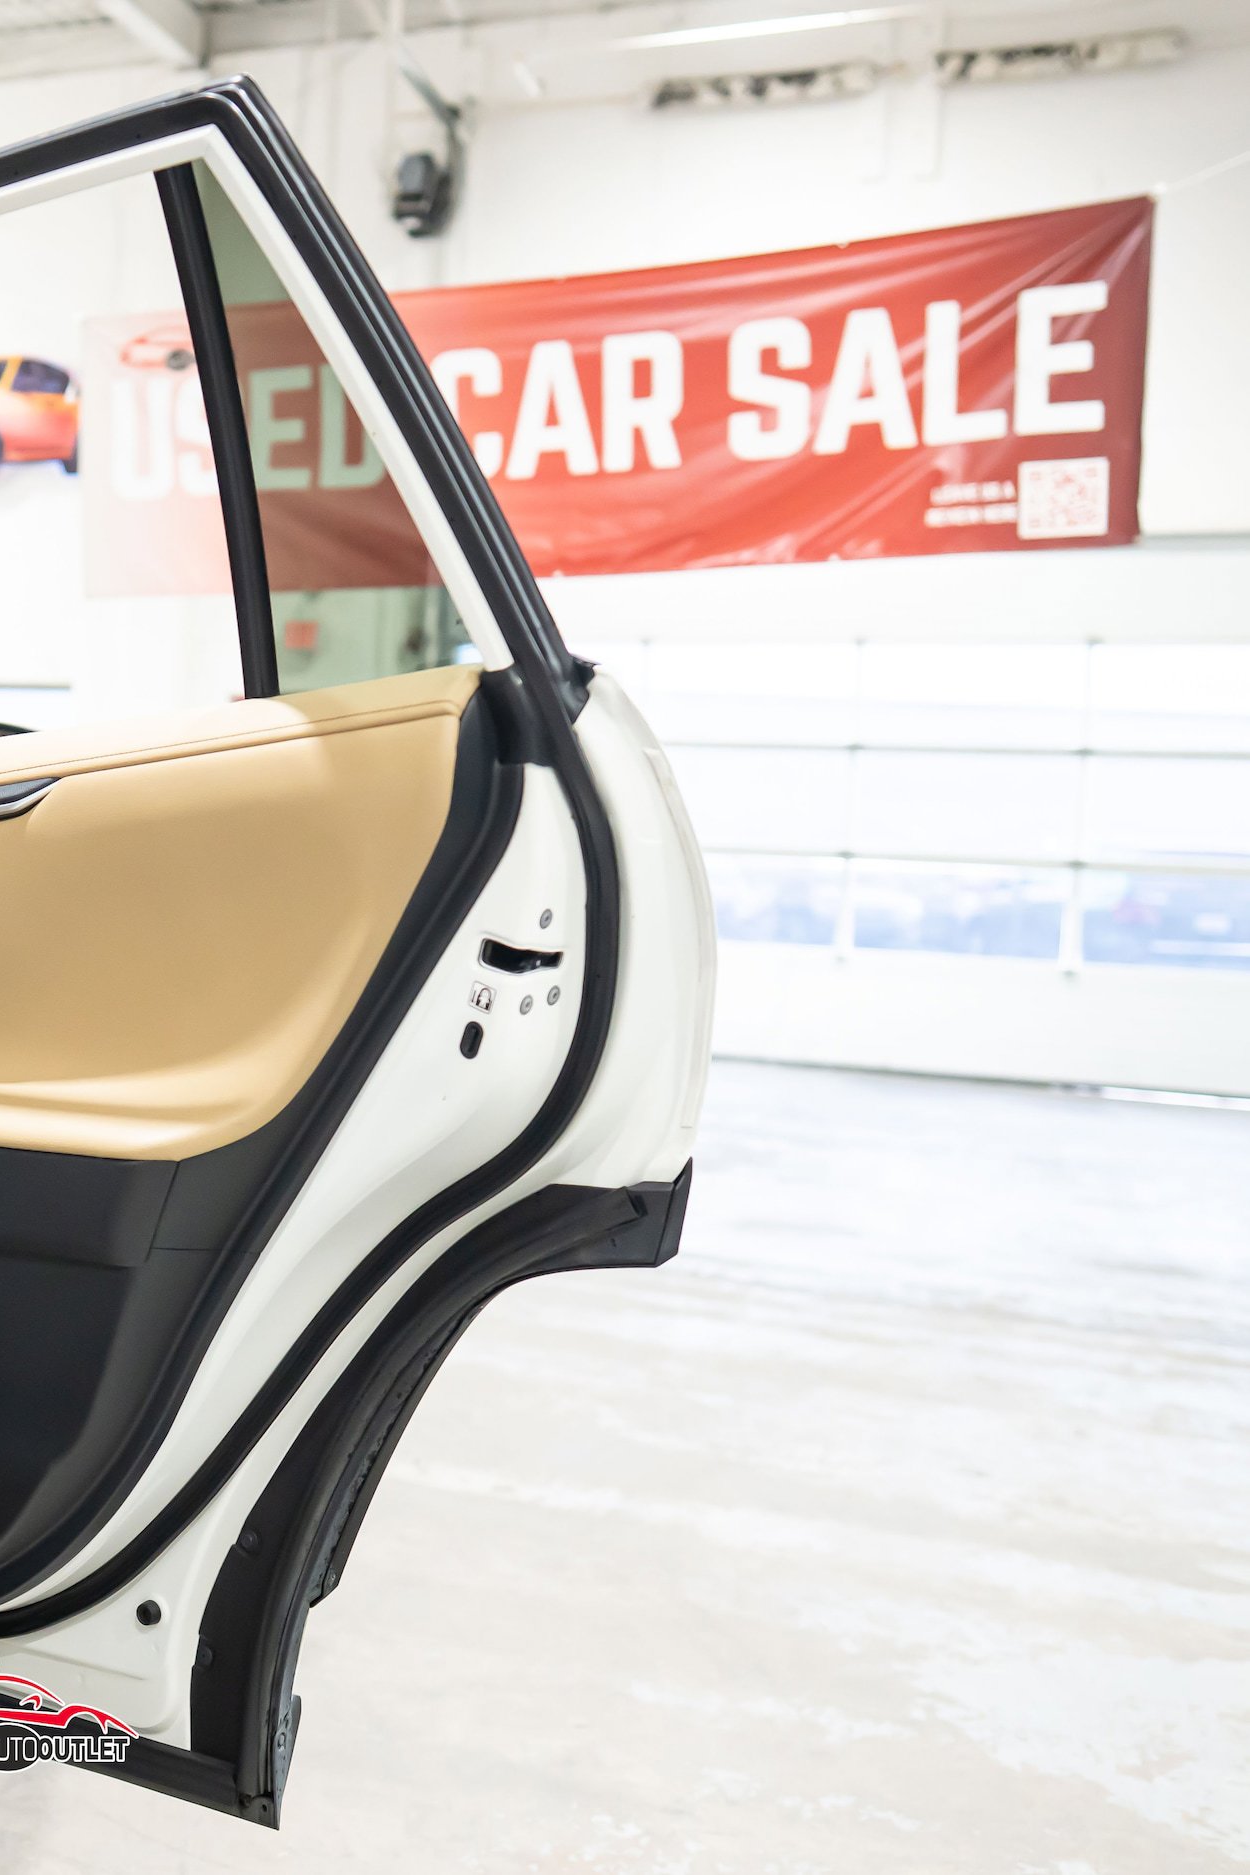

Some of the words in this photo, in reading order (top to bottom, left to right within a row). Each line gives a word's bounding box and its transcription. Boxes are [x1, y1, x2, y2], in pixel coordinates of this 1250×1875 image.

[110, 363, 386, 499] USED
[432, 331, 684, 479] CAR
[728, 281, 1110, 460] SALE
